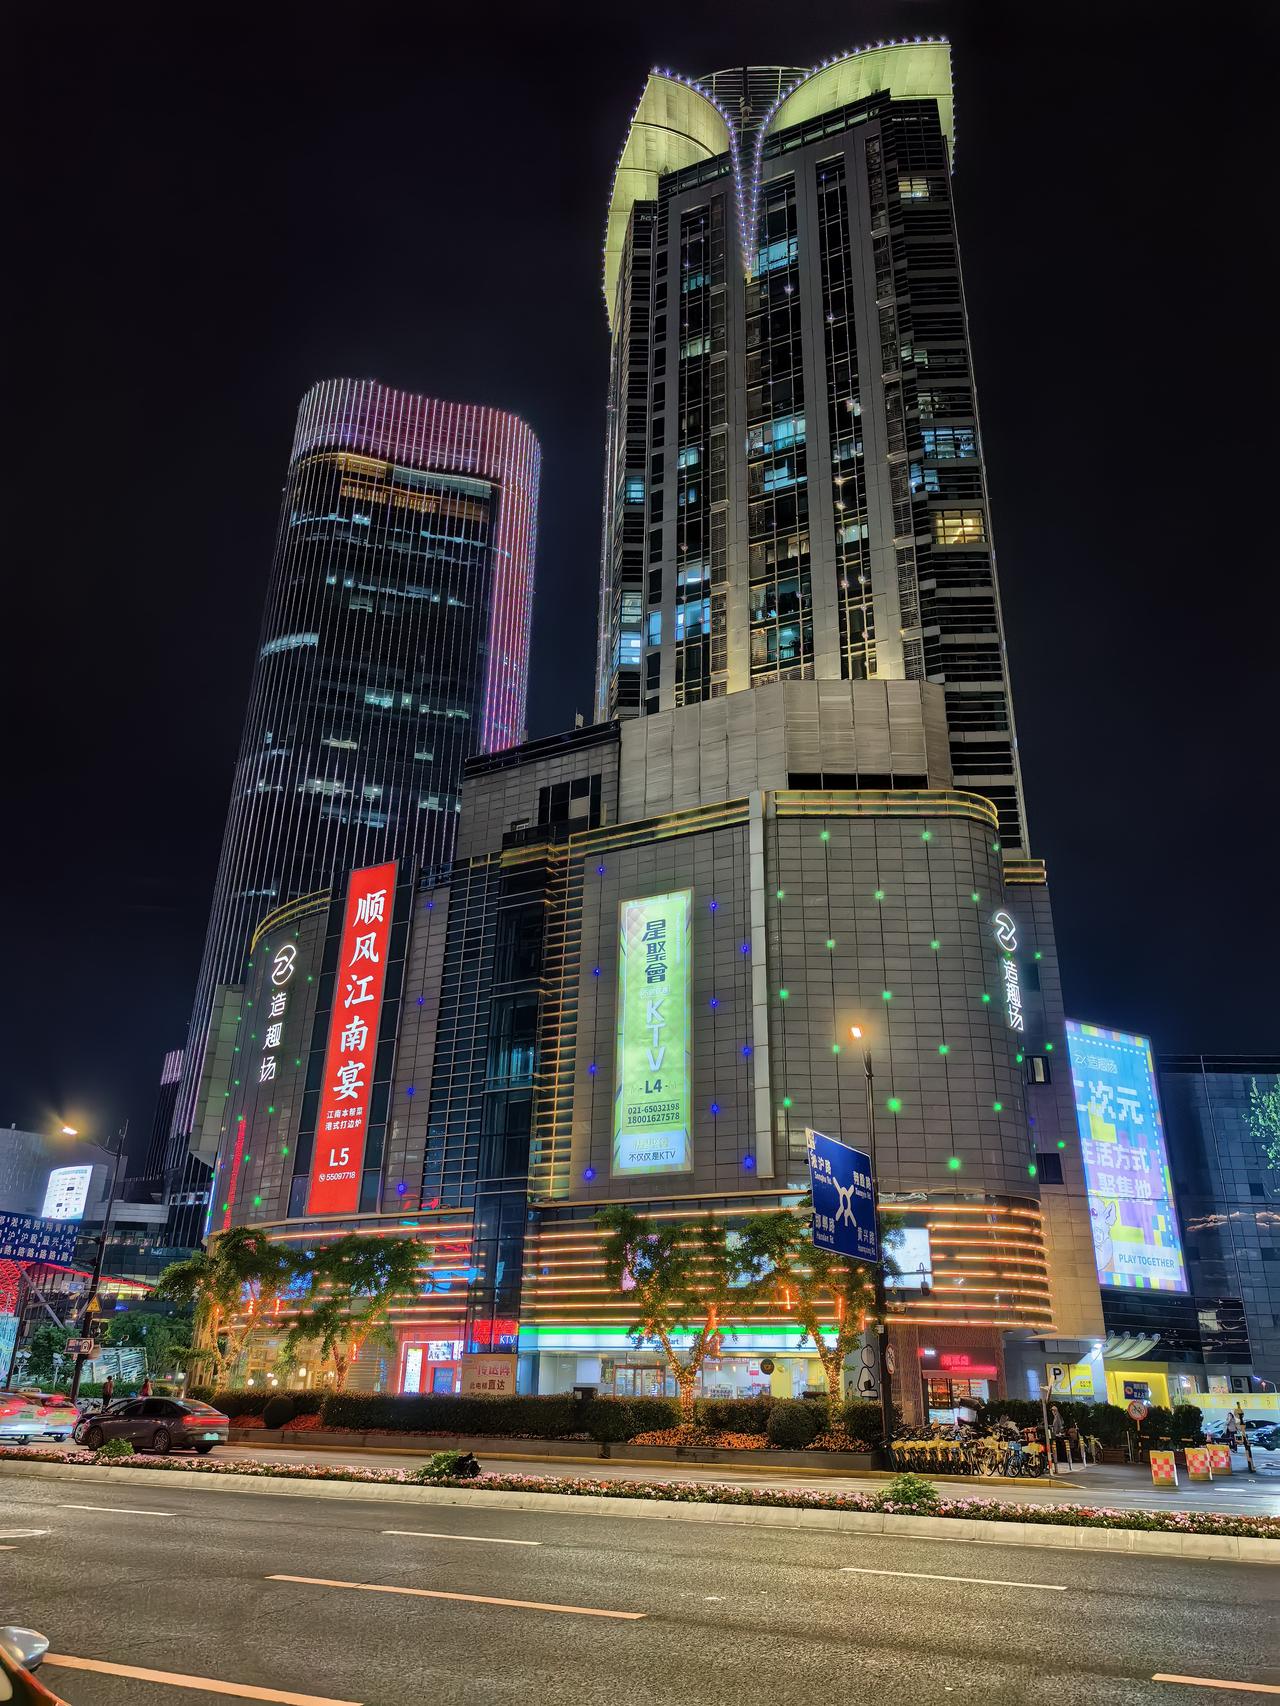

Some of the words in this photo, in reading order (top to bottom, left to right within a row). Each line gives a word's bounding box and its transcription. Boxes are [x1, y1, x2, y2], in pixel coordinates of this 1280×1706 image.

[641, 919, 668, 984] 星聚會
[333, 889, 387, 1100] 顺风江南宴
[259, 991, 287, 1083] 造趣场
[646, 999, 666, 1072] KTV
[645, 1079, 662, 1094] L4
[627, 1102, 680, 1115] 021-65032198
[627, 1112, 680, 1125] 18001627578
[329, 1147, 350, 1167] L5
[326, 1171, 356, 1181] 55097718
[1119, 1253, 1137, 1264] PLAY
[1138, 1255, 1175, 1269] TOGETHER
[500, 1336, 516, 1345] KTV
[1053, 1367, 1062, 1380] P
